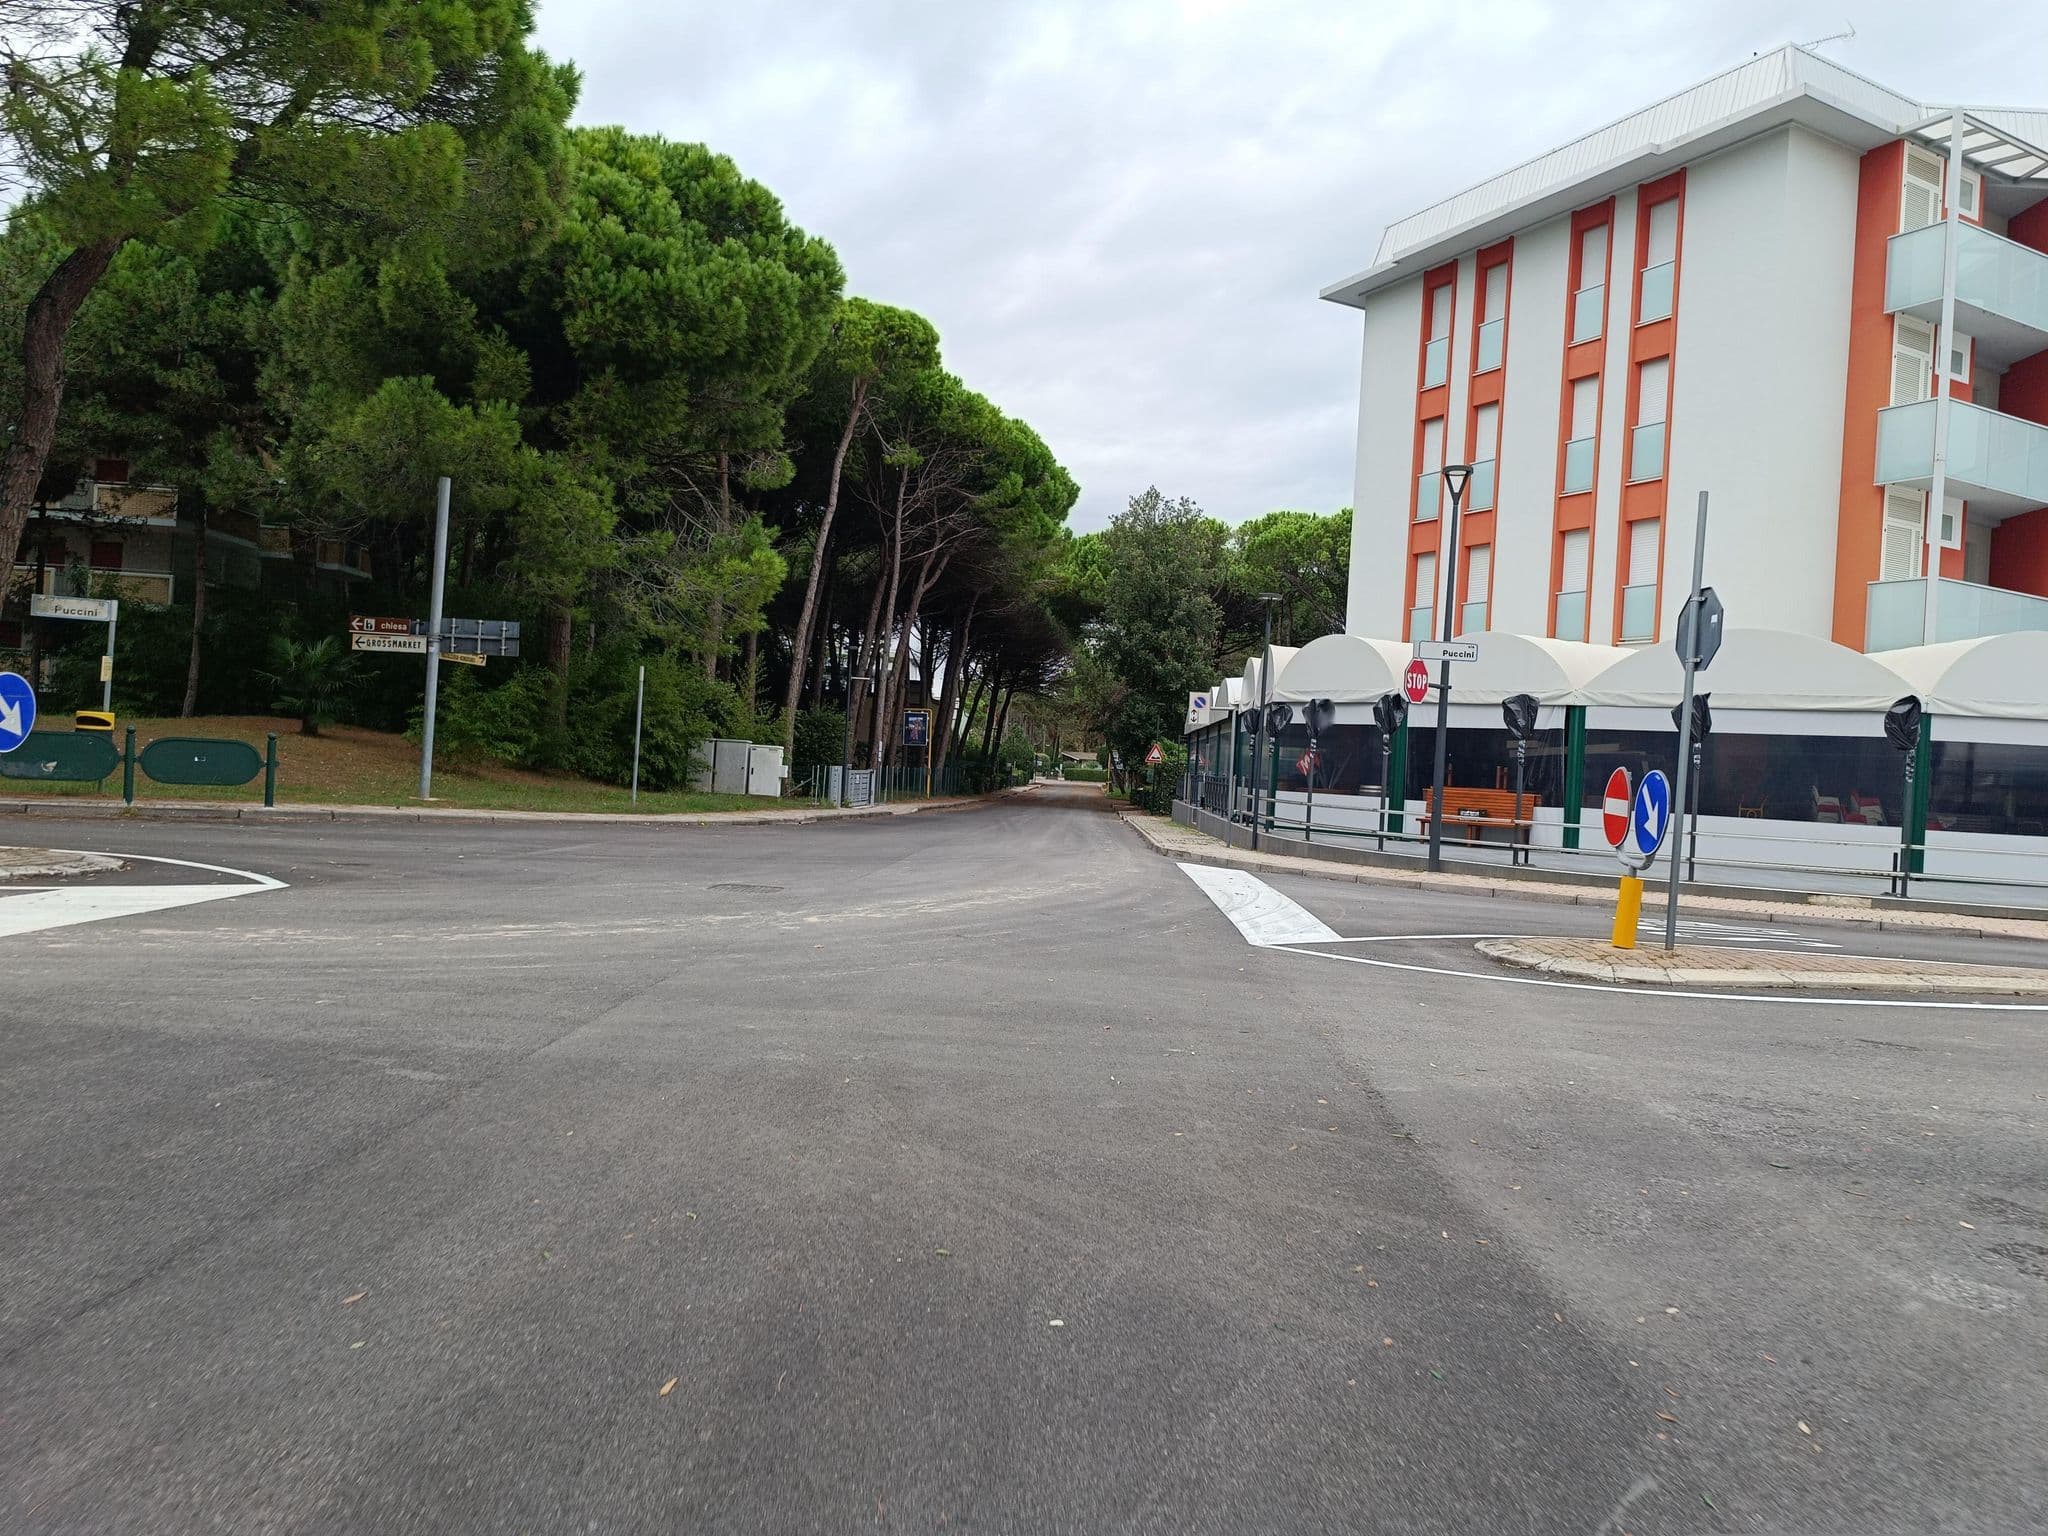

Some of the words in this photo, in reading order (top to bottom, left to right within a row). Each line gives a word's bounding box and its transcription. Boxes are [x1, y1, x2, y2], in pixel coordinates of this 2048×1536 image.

[54, 605, 98, 616] Puccini
[380, 621, 408, 631] chiesa
[366, 639, 422, 649] GROSSMARKET
[1442, 649, 1475, 658] Puccini
[1407, 672, 1427, 690] STOP
